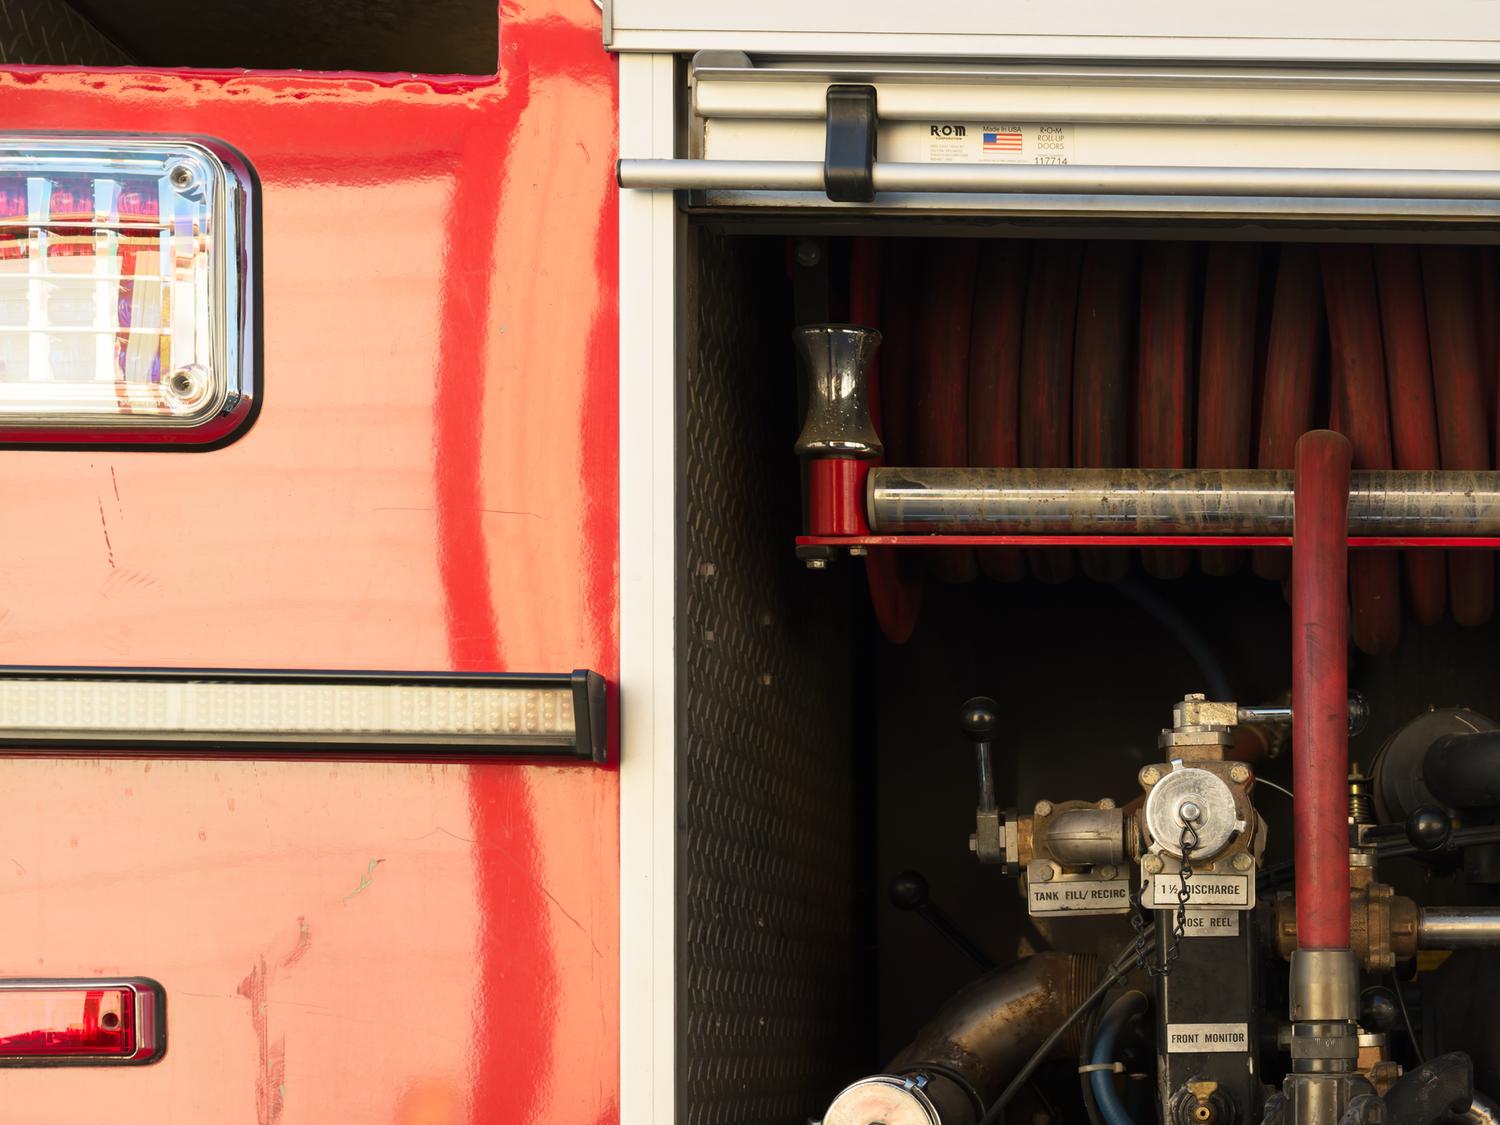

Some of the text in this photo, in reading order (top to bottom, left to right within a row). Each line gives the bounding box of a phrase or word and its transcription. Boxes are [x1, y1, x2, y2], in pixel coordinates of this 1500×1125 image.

[1035, 157, 1068, 165] 117714
[1034, 889, 1126, 901] TANK FILL/ RECIRC
[1161, 884, 1166, 894] 1
[1185, 884, 1241, 895] DISCHARGE
[1183, 917, 1232, 928] OSE REEL
[1171, 1033, 1245, 1044] FRONT MONITOR
